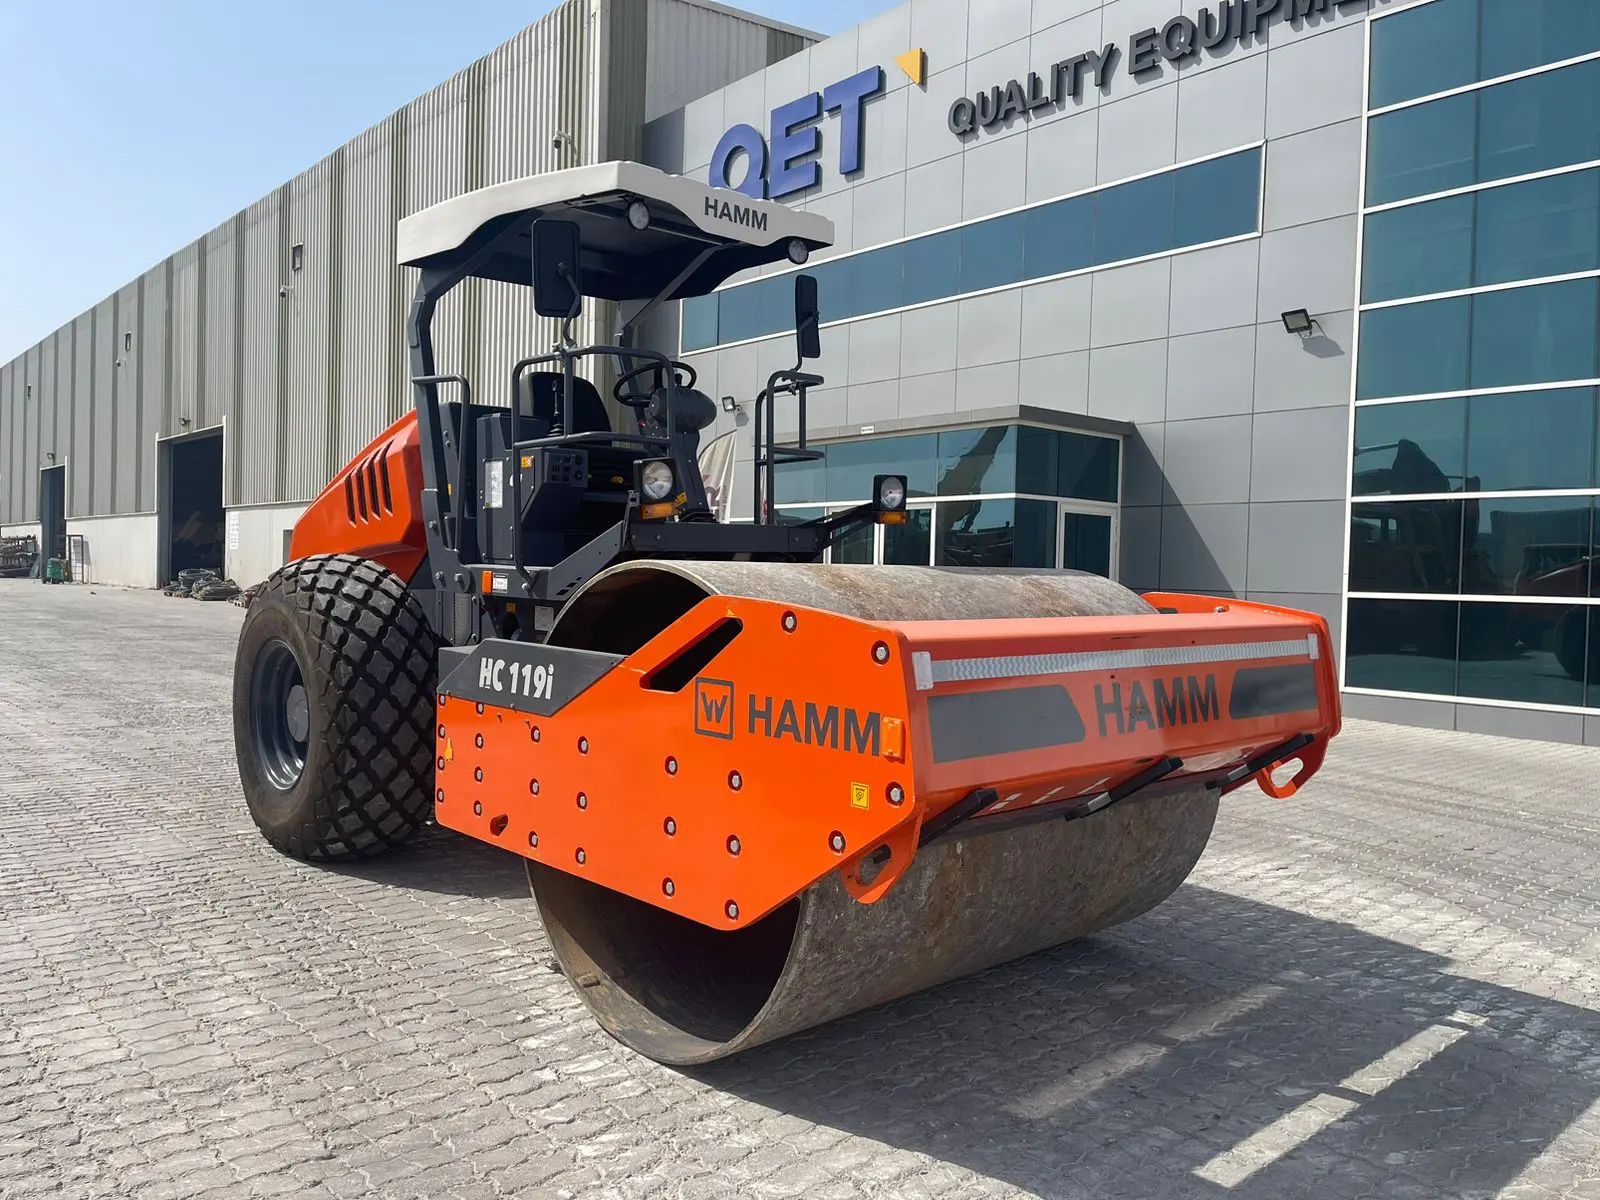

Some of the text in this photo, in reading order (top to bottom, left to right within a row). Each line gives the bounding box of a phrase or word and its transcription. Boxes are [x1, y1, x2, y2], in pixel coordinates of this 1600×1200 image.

[948, 42, 1115, 135] QUALITY
[709, 65, 880, 200] QET
[704, 196, 768, 232] HAMM
[479, 657, 554, 700] HC 119i
[1093, 674, 1219, 737] HAMM
[748, 694, 881, 757] HAMM
